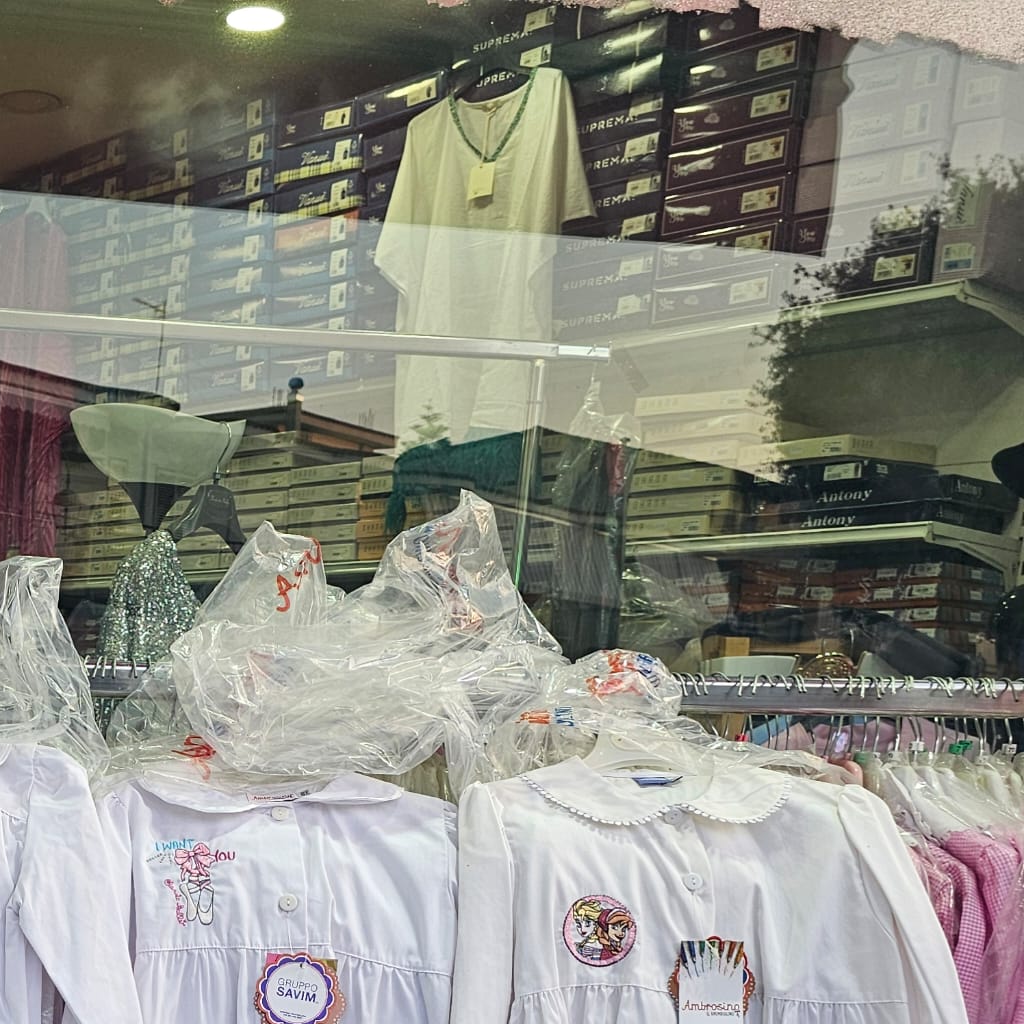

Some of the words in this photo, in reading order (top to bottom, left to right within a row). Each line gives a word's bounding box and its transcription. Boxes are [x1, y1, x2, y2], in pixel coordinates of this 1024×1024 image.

[816, 486, 873, 505] Antony
[801, 511, 856, 529] Antony
[162, 838, 195, 851] WANT
[277, 977, 319, 993] GRUPPO
[276, 987, 317, 1003] SAVIM
